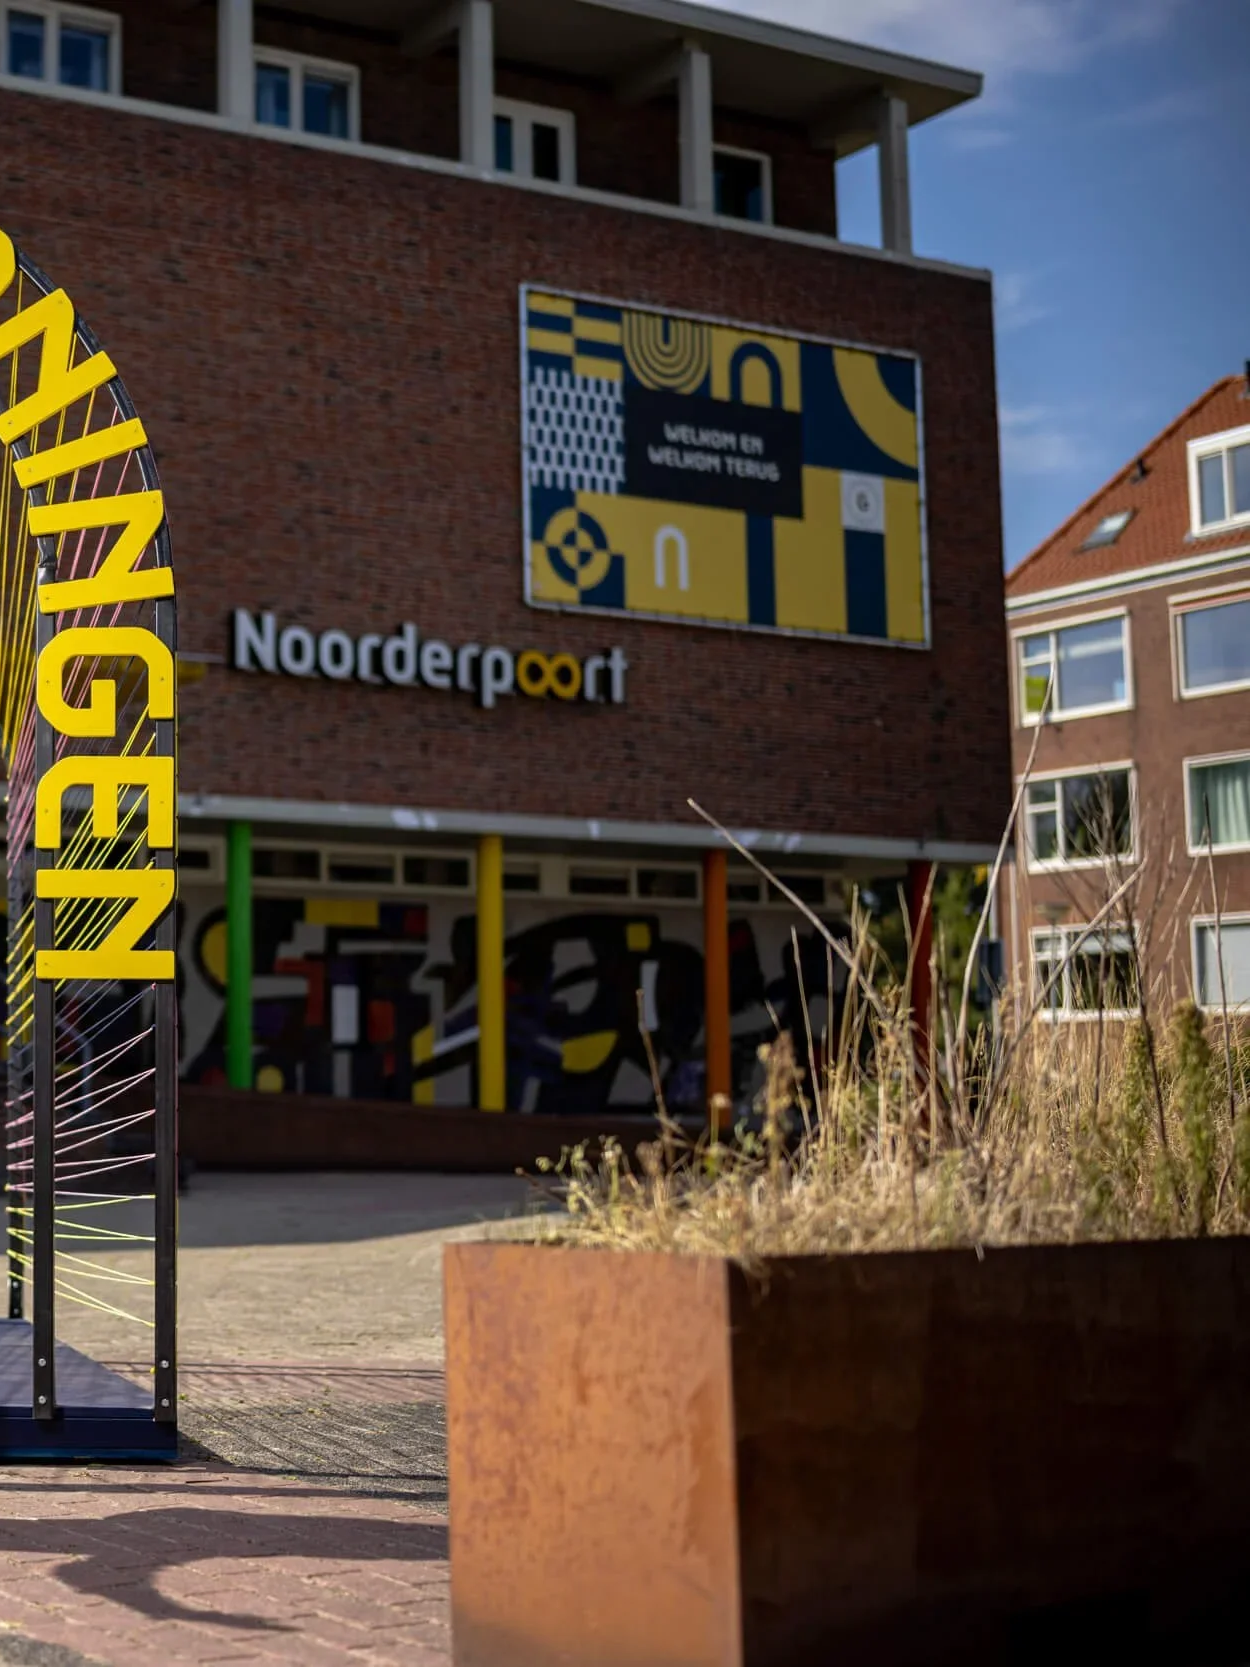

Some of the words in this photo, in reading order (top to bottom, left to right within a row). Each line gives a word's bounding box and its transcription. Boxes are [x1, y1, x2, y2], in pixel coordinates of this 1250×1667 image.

[663, 422, 737, 452] WELKOM
[740, 433, 764, 456] EN
[647, 443, 721, 474] WELKOM
[724, 456, 780, 482] TERUG
[234, 607, 628, 708] Noorderpoort
